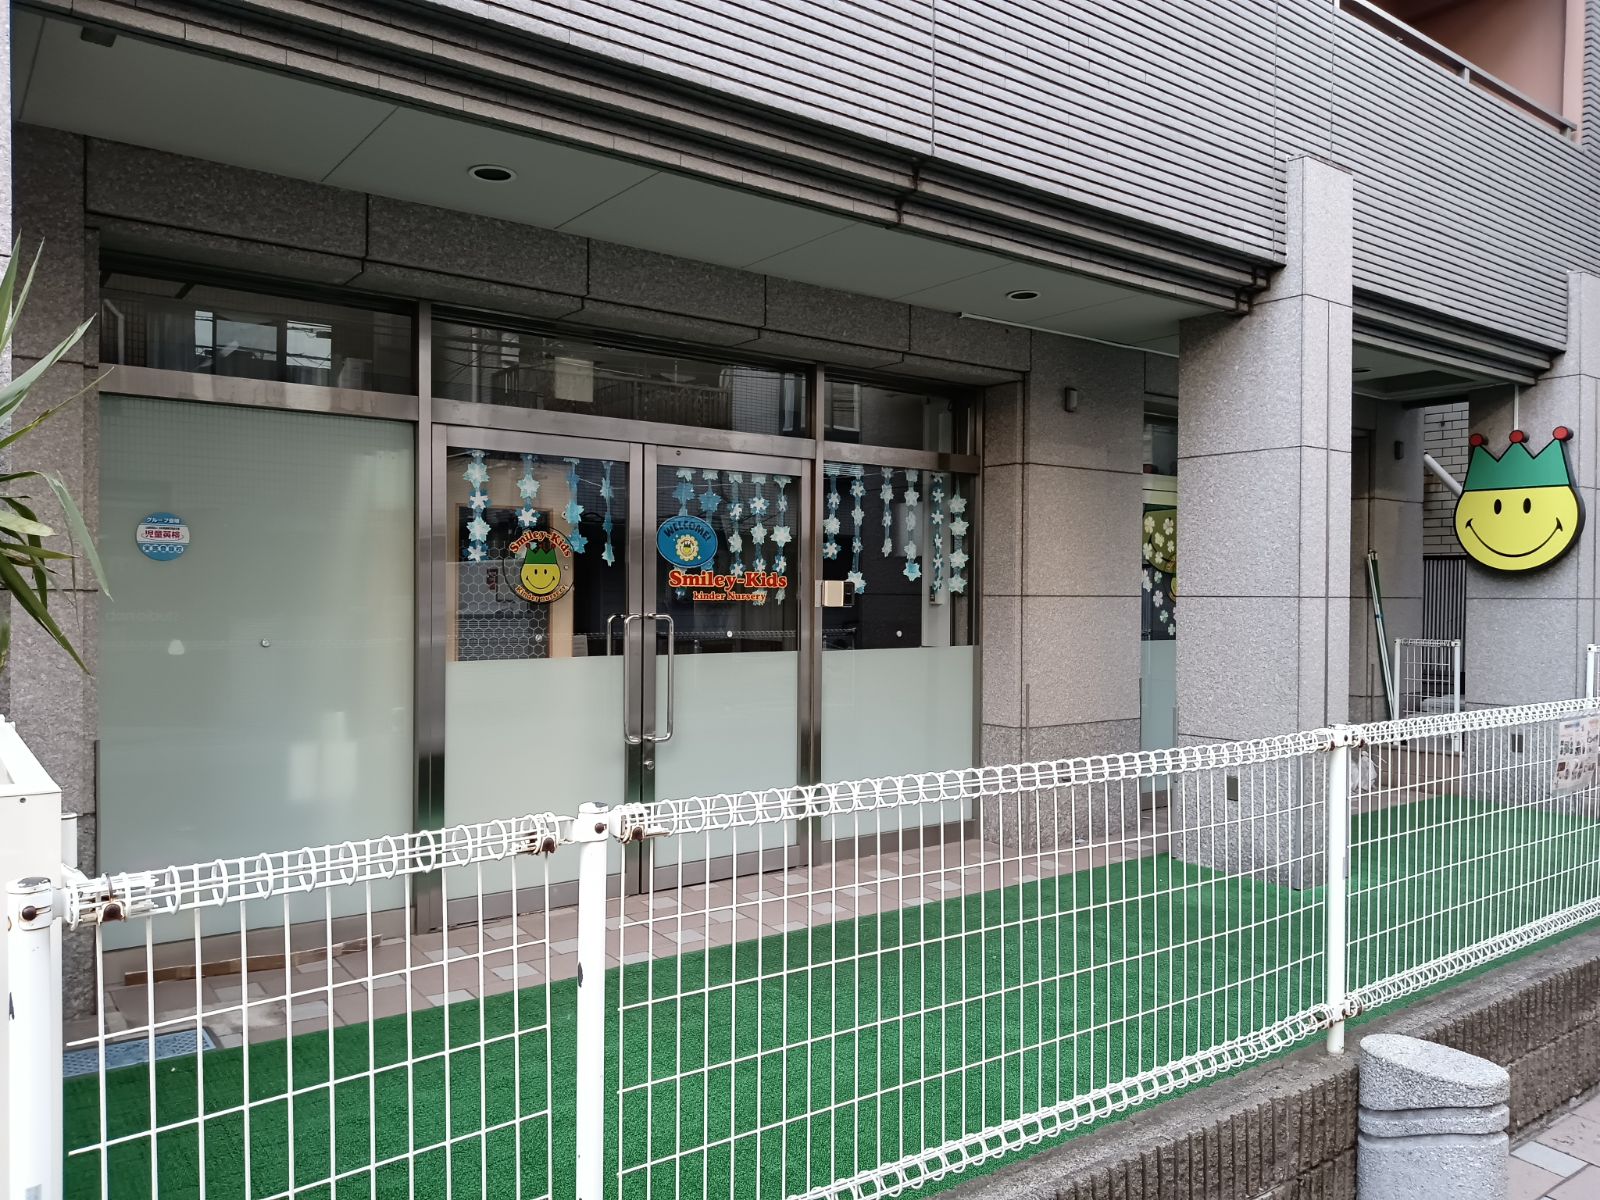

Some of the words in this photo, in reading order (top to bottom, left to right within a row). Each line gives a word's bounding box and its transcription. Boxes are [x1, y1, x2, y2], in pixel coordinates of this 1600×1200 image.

[663, 520, 711, 541] WELCOME!
[508, 530, 571, 557] Smiley-Kids
[669, 570, 787, 592] Smiley-Kids
[693, 591, 725, 601] kinder
[727, 591, 767, 602] Nursery
